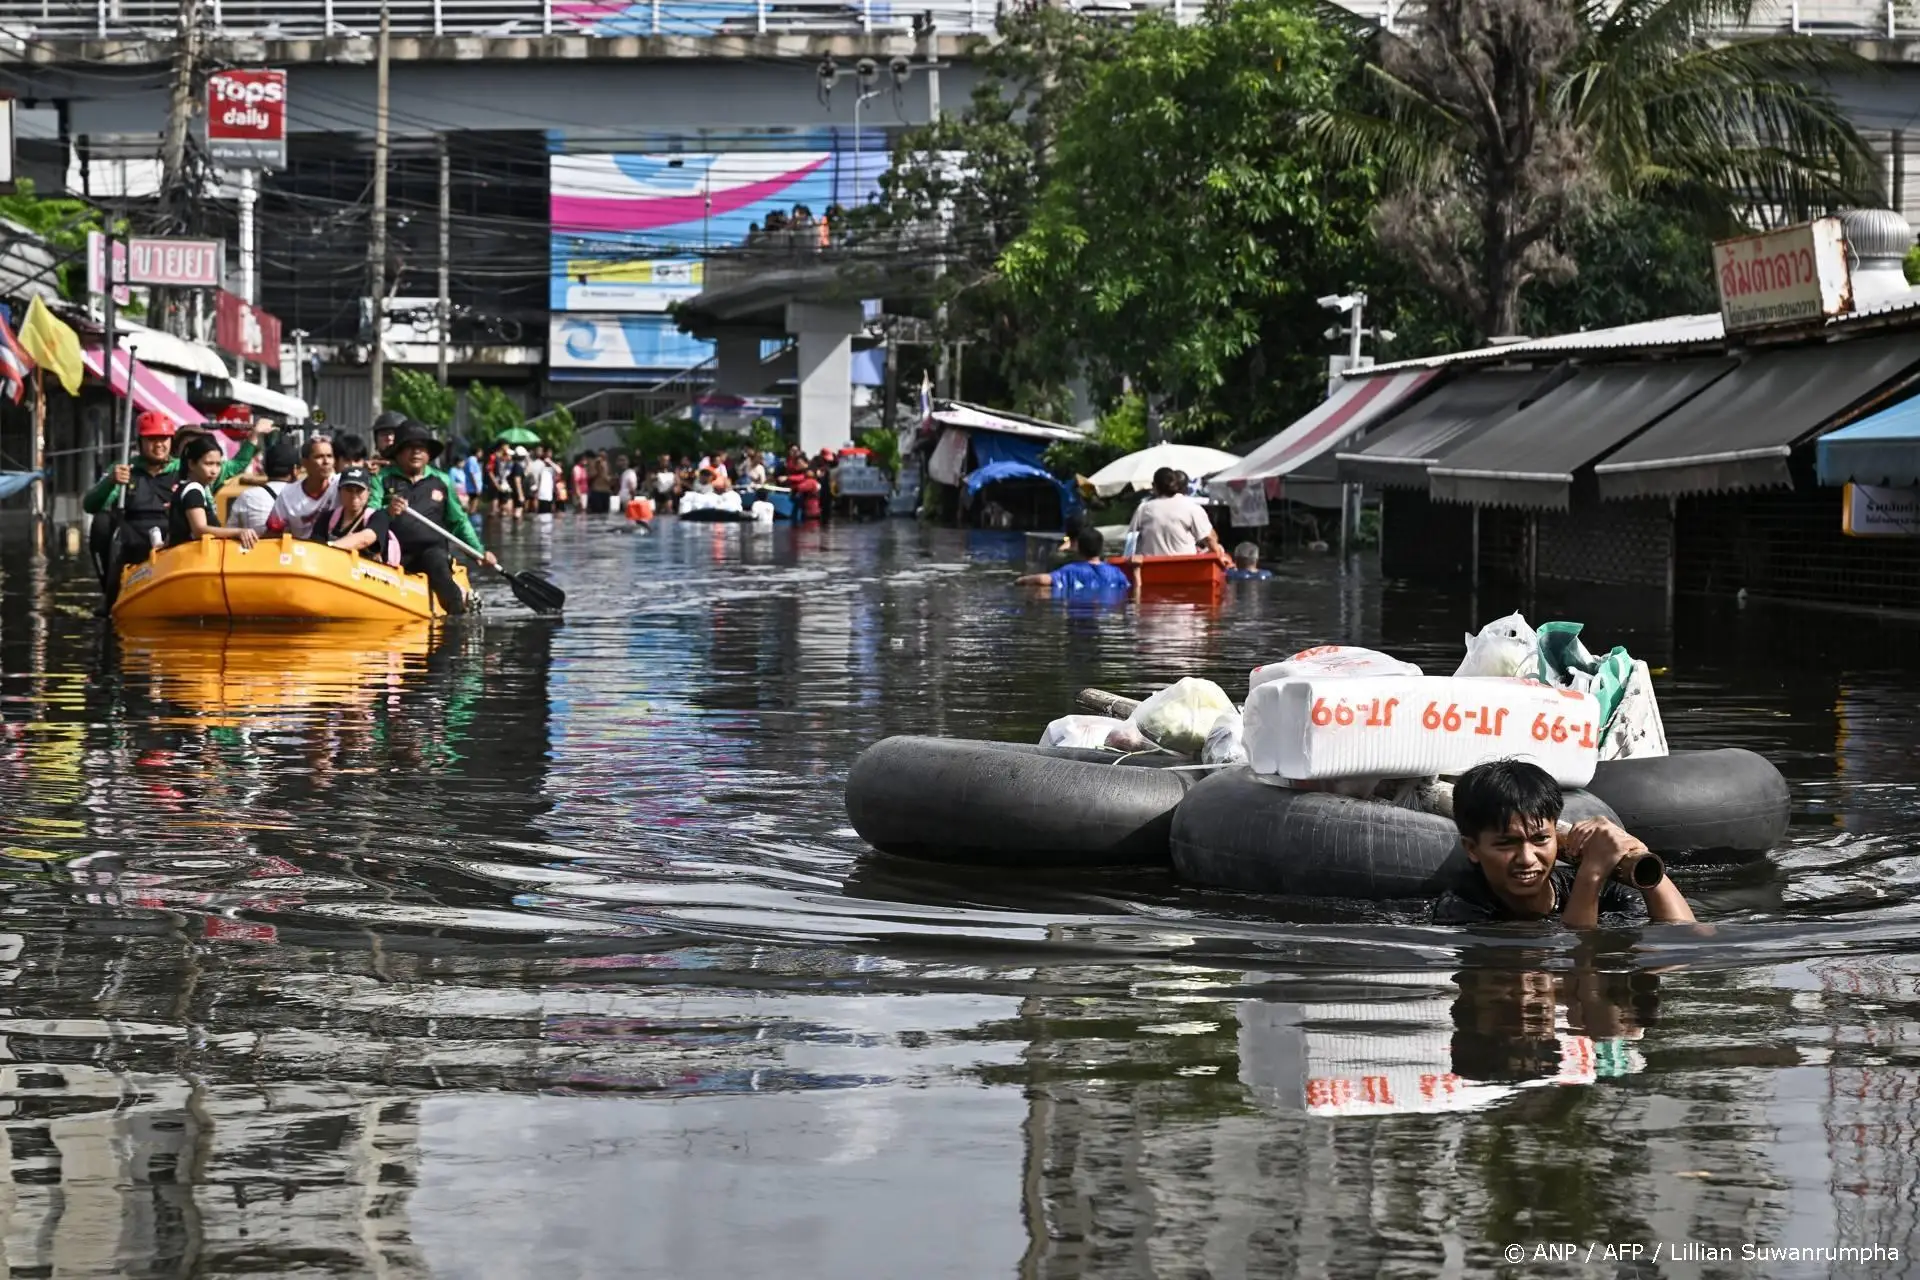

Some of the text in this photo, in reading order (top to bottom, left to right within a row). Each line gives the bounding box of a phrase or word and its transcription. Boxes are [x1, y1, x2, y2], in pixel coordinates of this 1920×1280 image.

[210, 76, 283, 108] Tops
[223, 107, 269, 130] daily
[133, 245, 216, 281] ขายยา
[1720, 239, 1813, 299] ส้มตำลาว
[1311, 697, 1399, 727] JT-99
[1422, 702, 1508, 737] JT-99
[1531, 712, 1599, 749] T-99
